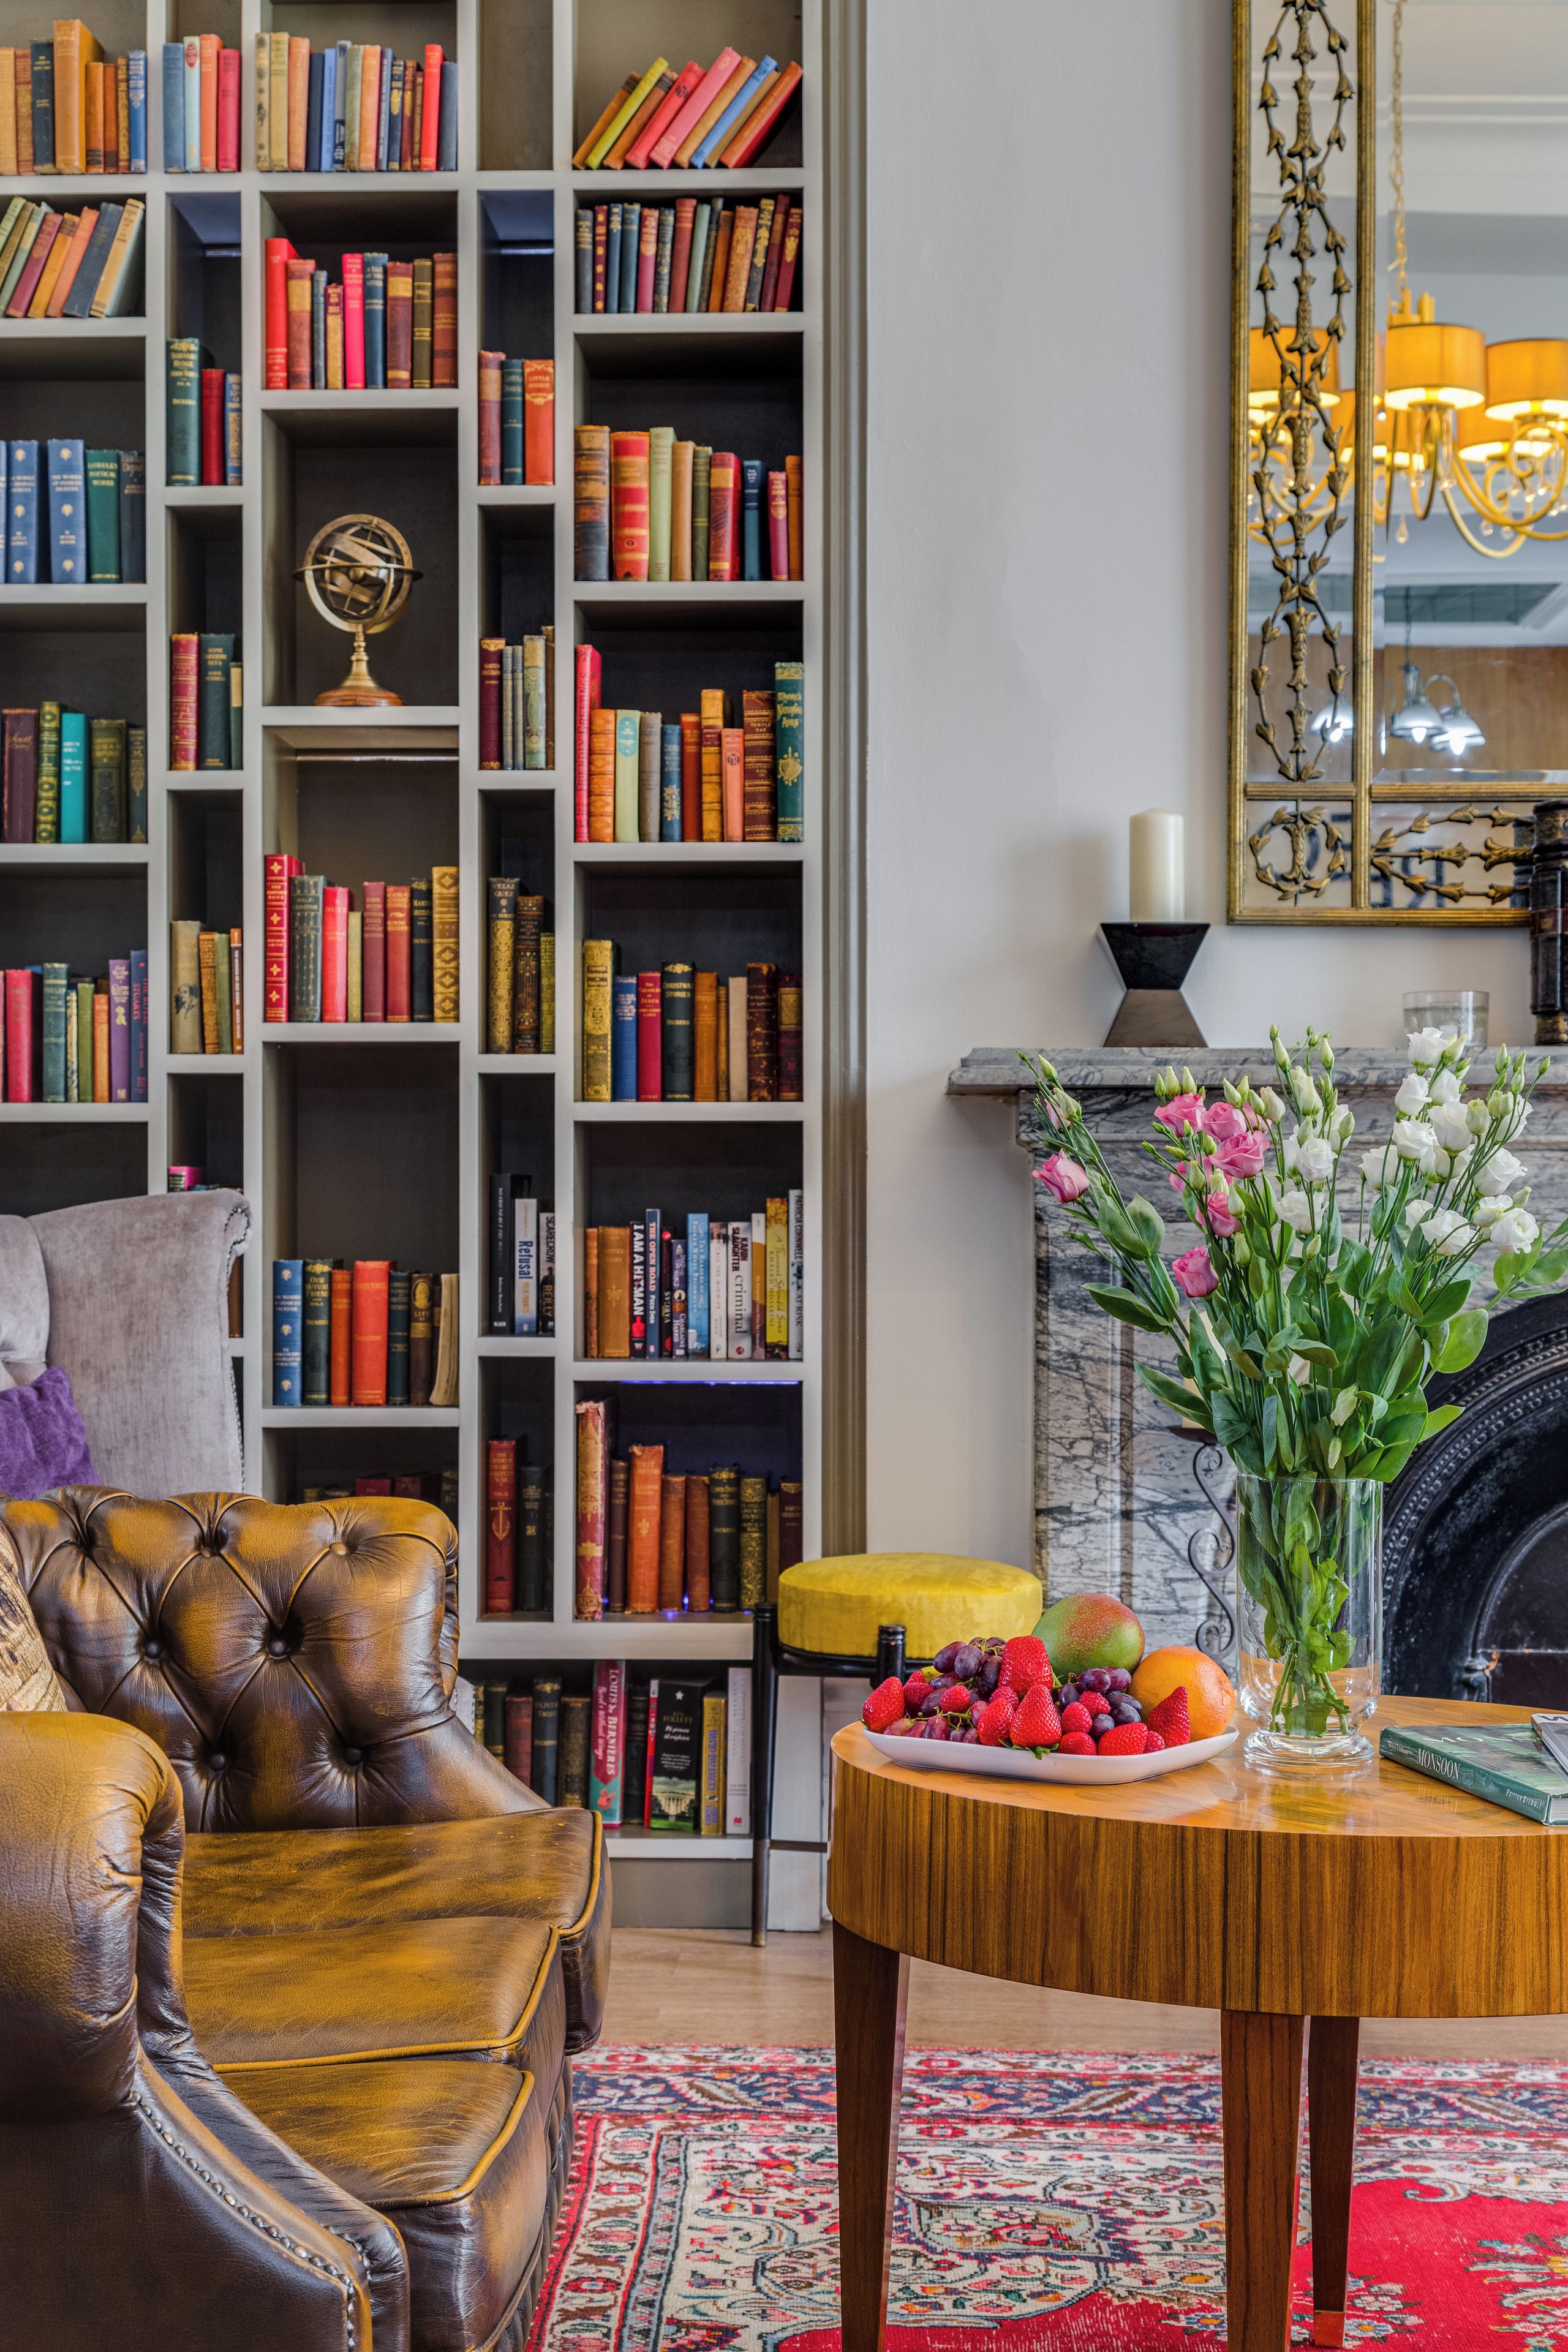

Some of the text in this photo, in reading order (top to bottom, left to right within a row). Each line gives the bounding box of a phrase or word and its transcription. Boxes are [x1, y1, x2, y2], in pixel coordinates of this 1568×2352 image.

[576, 672, 589, 792] FRIENDLY GREETINGS
[782, 717, 799, 728] AIRS
[794, 1196, 803, 1224] PATRICIA
[546, 1216, 555, 1263] SCARECROW
[633, 1232, 644, 1251] AM
[731, 1227, 740, 1271] SLAUGHTER
[519, 1241, 533, 1279] Refusal
[633, 1254, 644, 1263] A
[775, 1246, 786, 1276] Thousand
[543, 1284, 552, 1317] REILLY
[633, 1265, 644, 1315] HITMAN
[734, 1275, 748, 1333] criminal
[775, 1278, 785, 1311] Splendid
[796, 1294, 802, 1305] AT
[609, 1669, 619, 1703] LOUIS
[595, 1738, 604, 1760] Wings
[1416, 1747, 1461, 1781] MONSOON
[1506, 1789, 1543, 1809] EDITION STEMMLE
